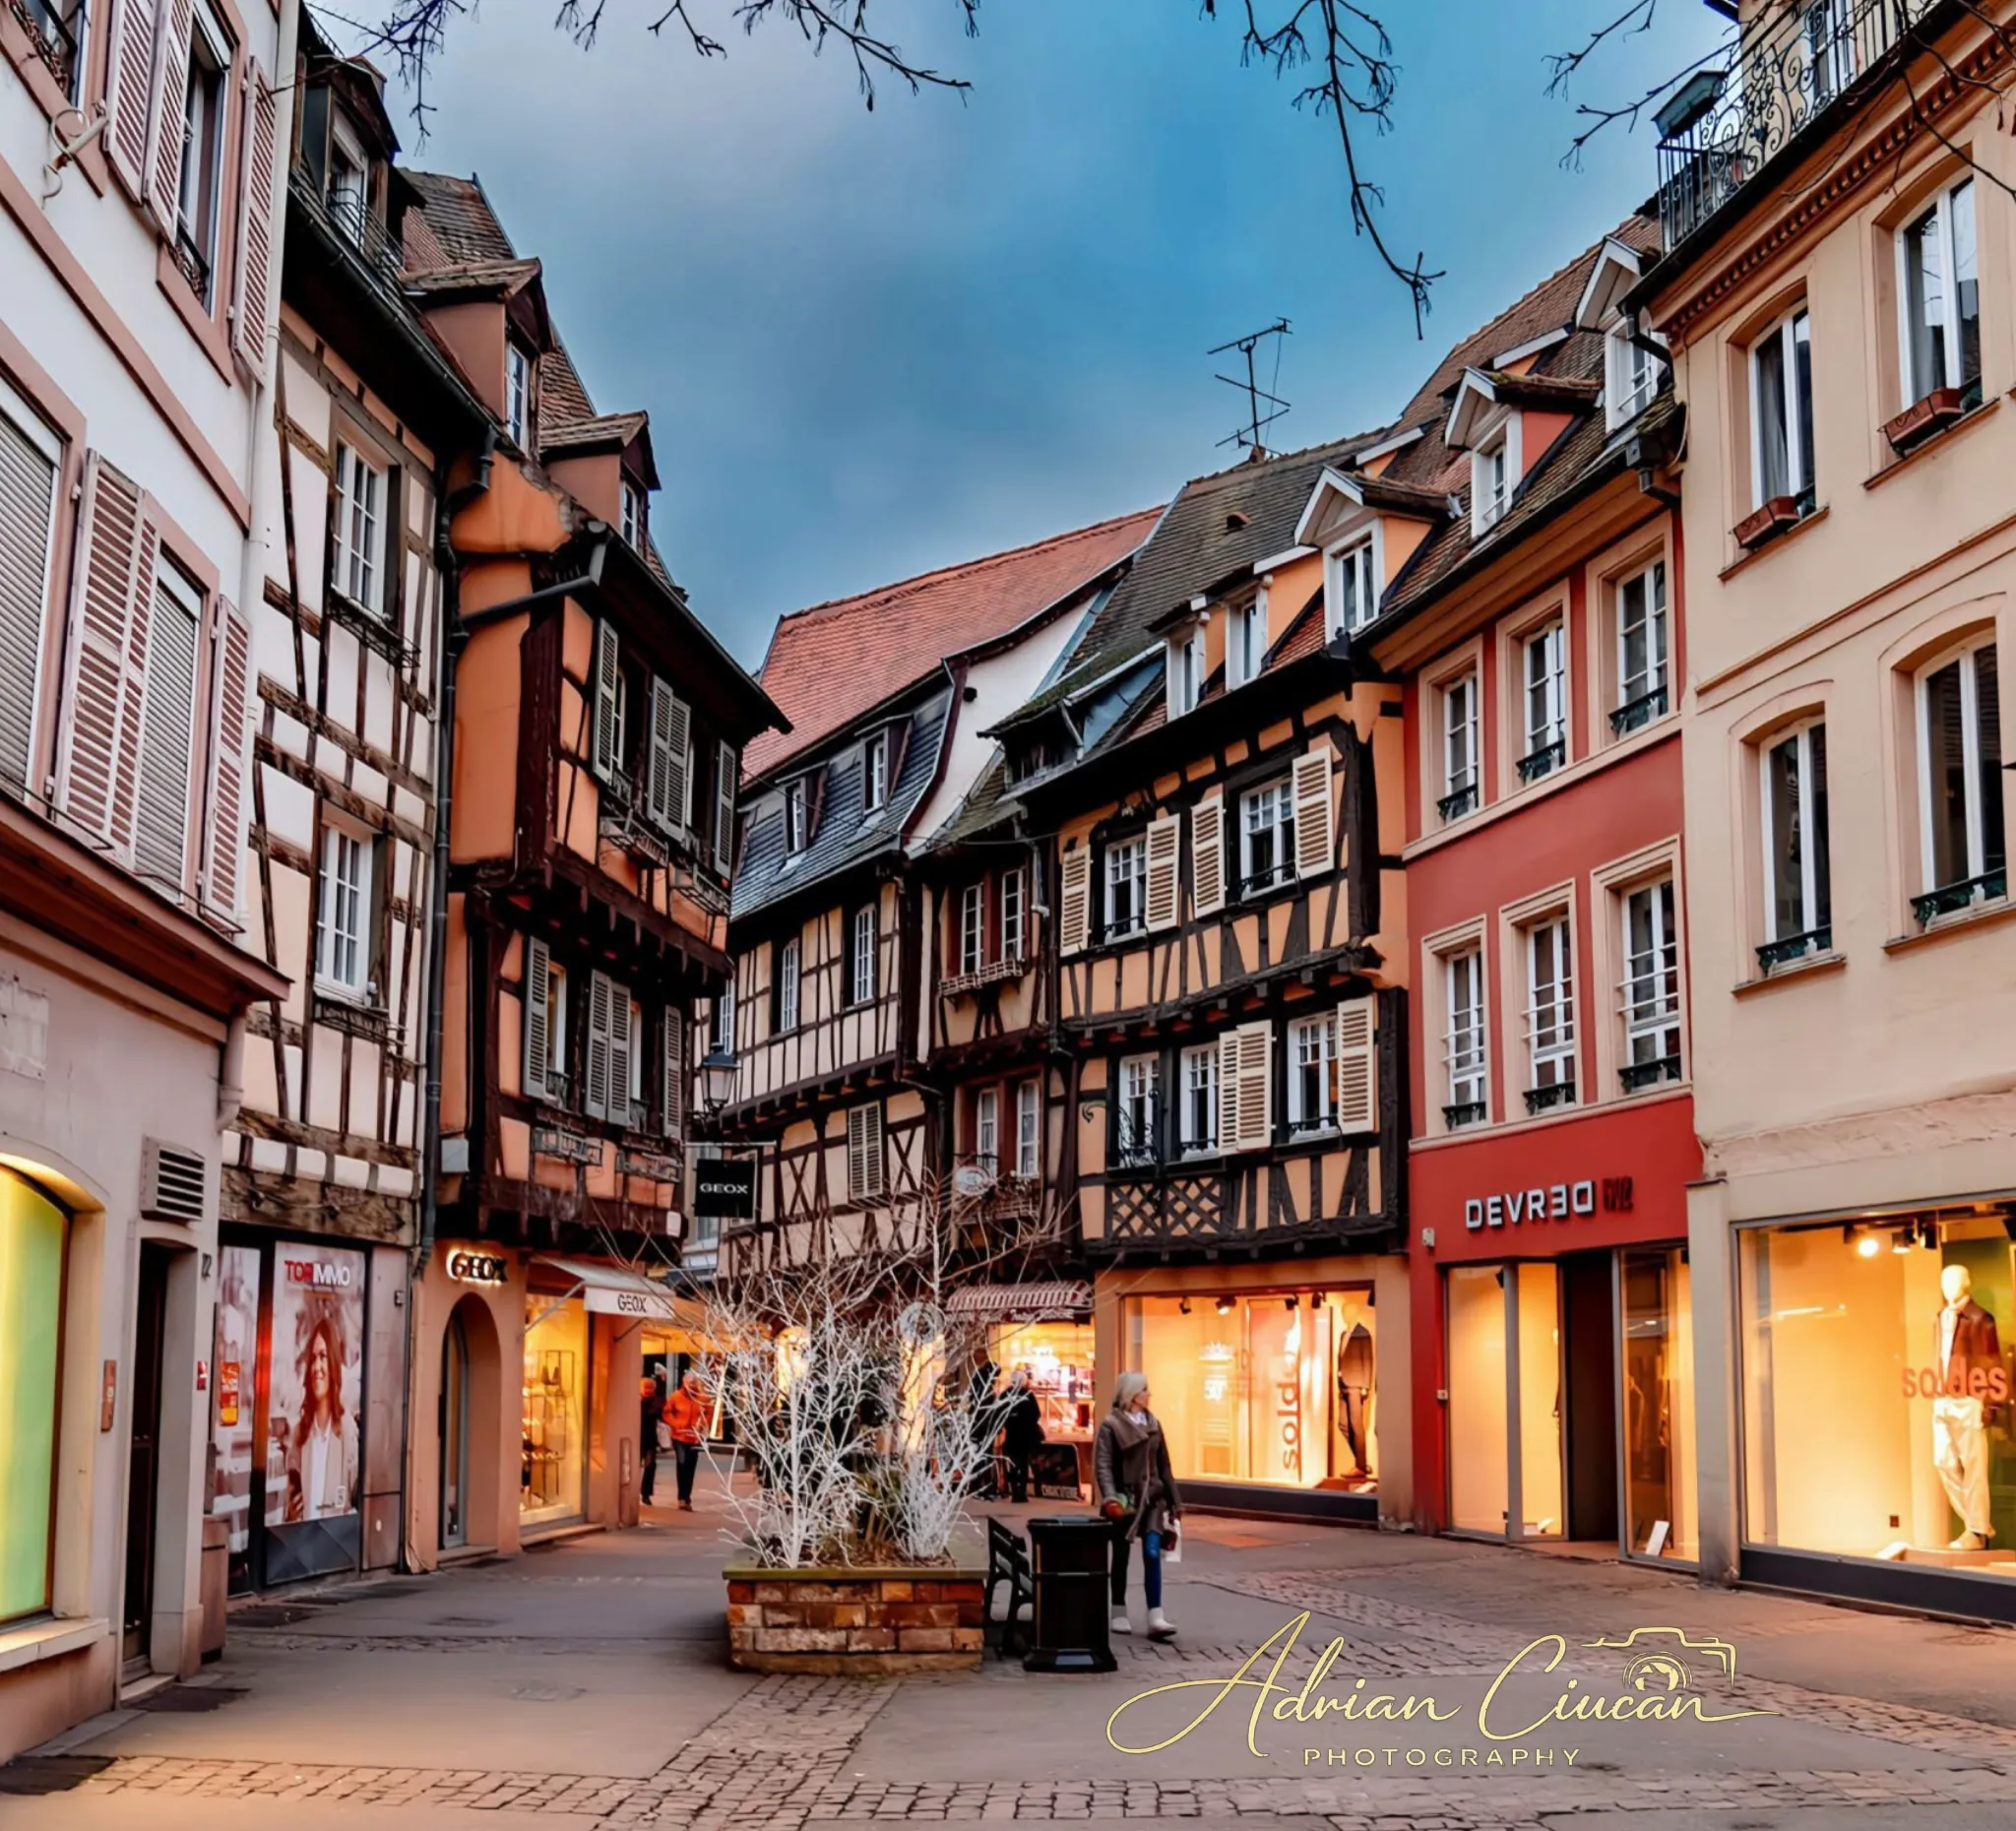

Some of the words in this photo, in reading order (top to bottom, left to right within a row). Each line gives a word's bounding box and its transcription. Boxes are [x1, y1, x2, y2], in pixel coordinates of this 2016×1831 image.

[700, 1182, 748, 1194] GEOX
[449, 1251, 508, 1284] GEOX
[617, 1294, 647, 1312] GEOX
[1902, 1355, 2008, 1401] soldes
